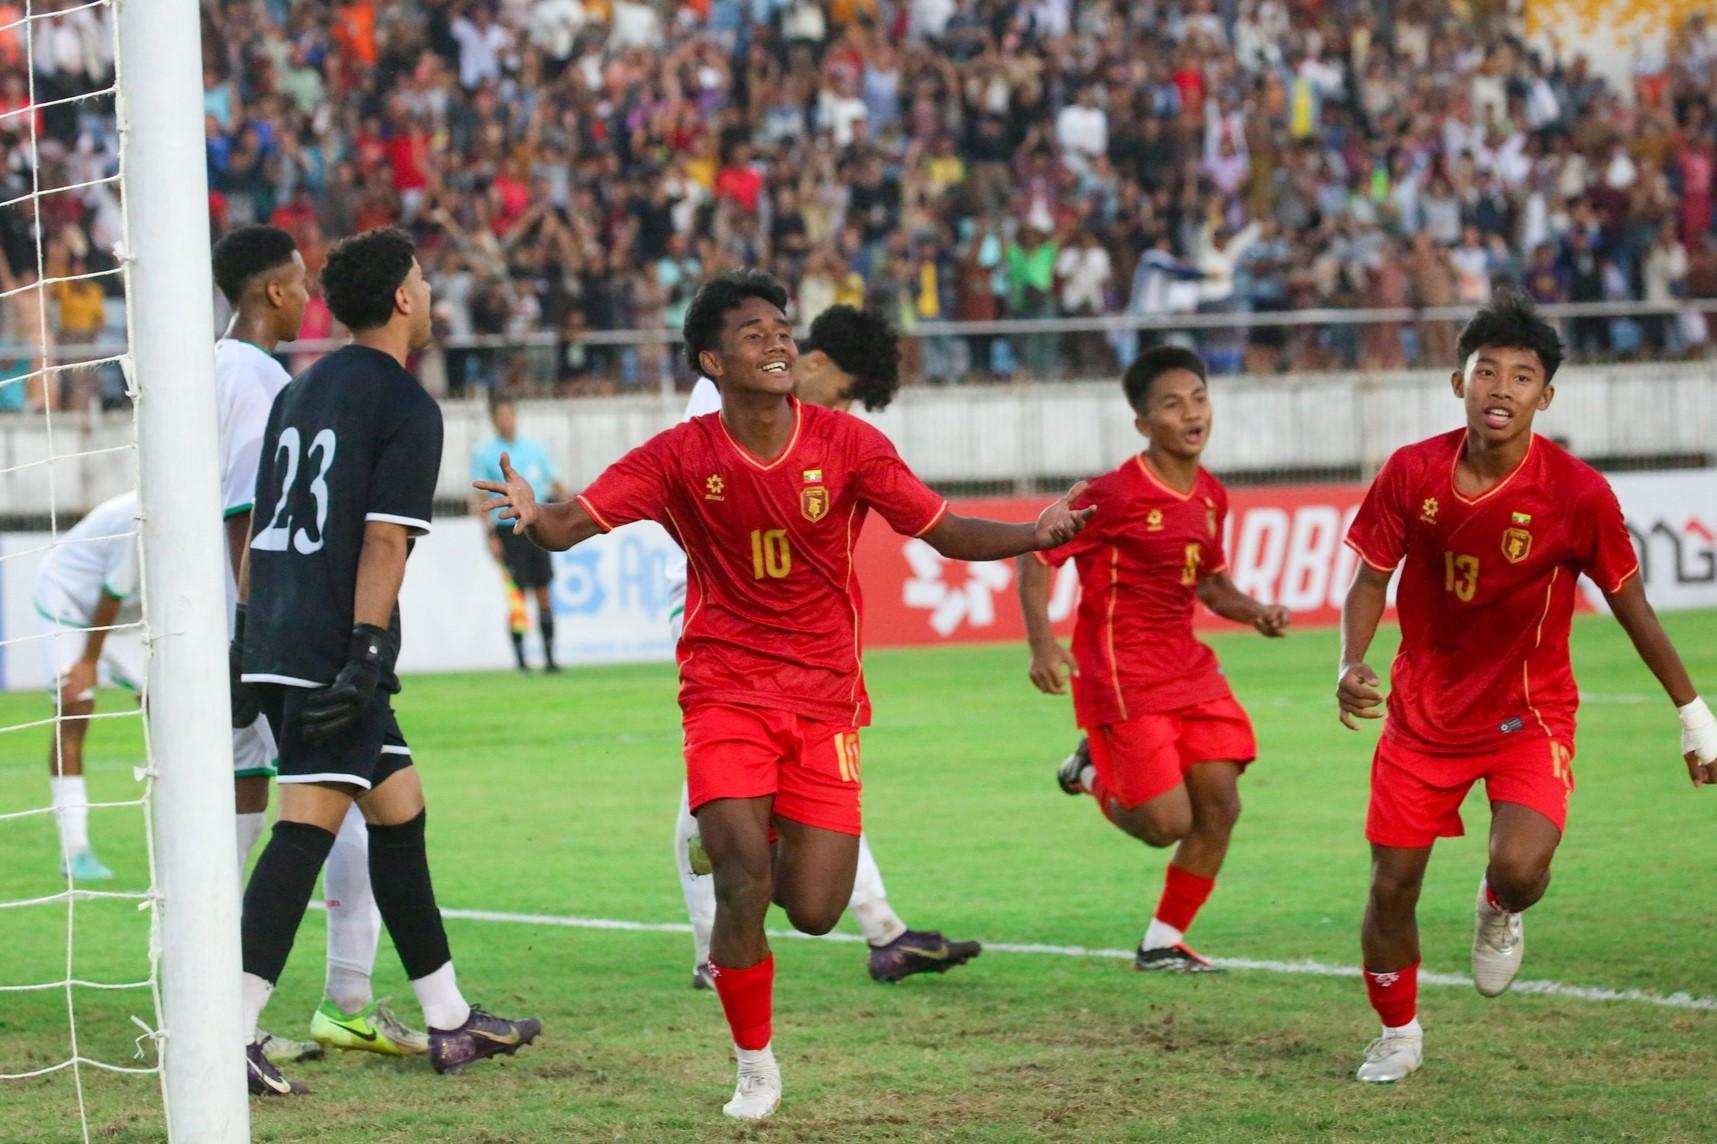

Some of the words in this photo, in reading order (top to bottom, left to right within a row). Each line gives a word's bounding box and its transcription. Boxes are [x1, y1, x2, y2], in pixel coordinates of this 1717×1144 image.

[250, 426, 336, 555] 23
[750, 528, 792, 580] 10
[1444, 550, 1480, 602] 13
